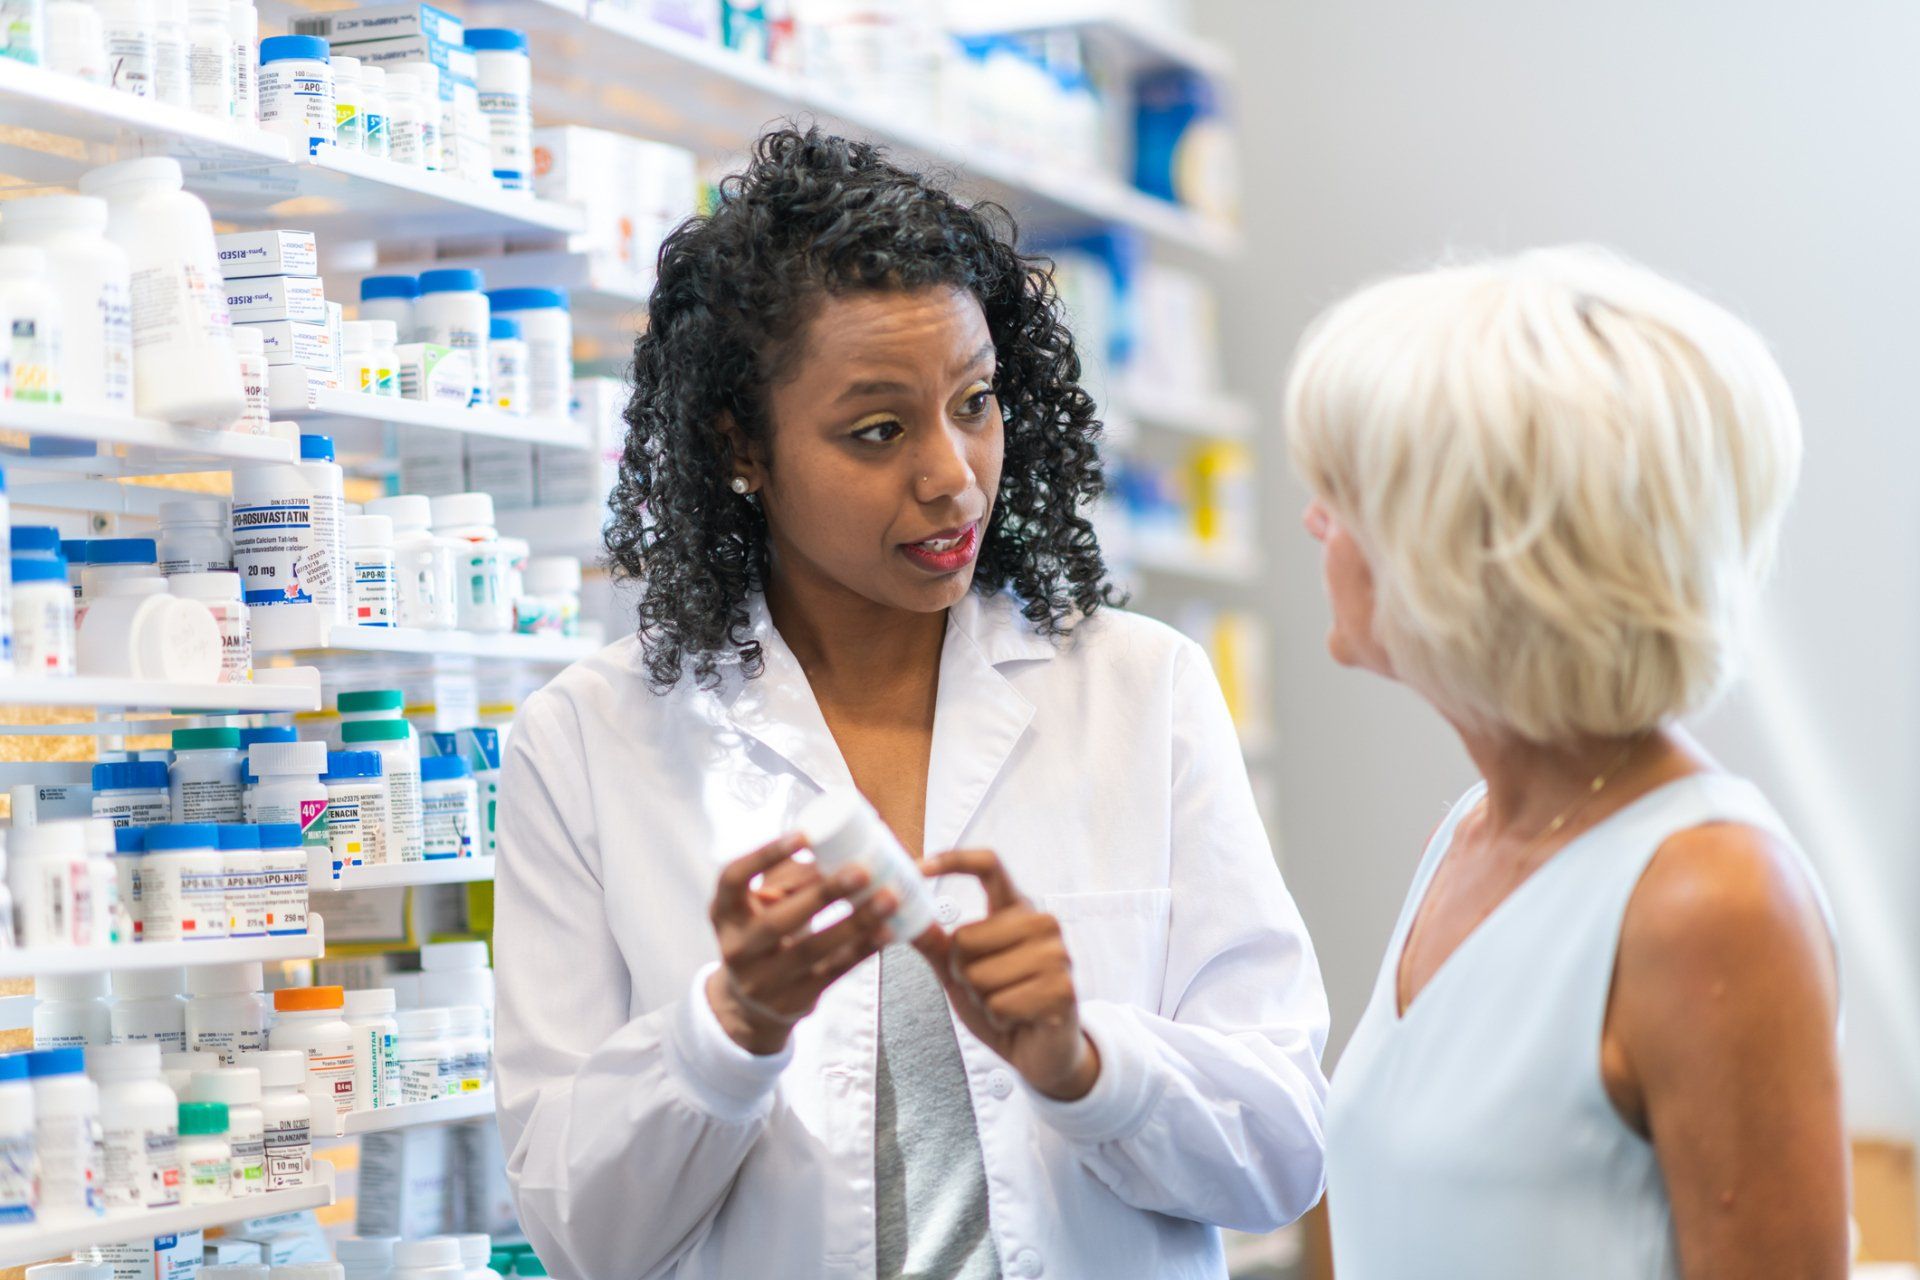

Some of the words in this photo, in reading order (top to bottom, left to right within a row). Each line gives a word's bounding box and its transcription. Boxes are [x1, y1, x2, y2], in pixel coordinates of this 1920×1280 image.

[218, 247, 266, 260] pms-RISED
[248, 565, 258, 576] 20
[260, 566, 276, 577] mg
[40, 789, 46, 800] 6
[302, 804, 316, 816] 40
[284, 914, 296, 922] 250
[280, 1120, 291, 1129] DIN
[276, 1161, 286, 1170] 10
[288, 1162, 300, 1170] mg
